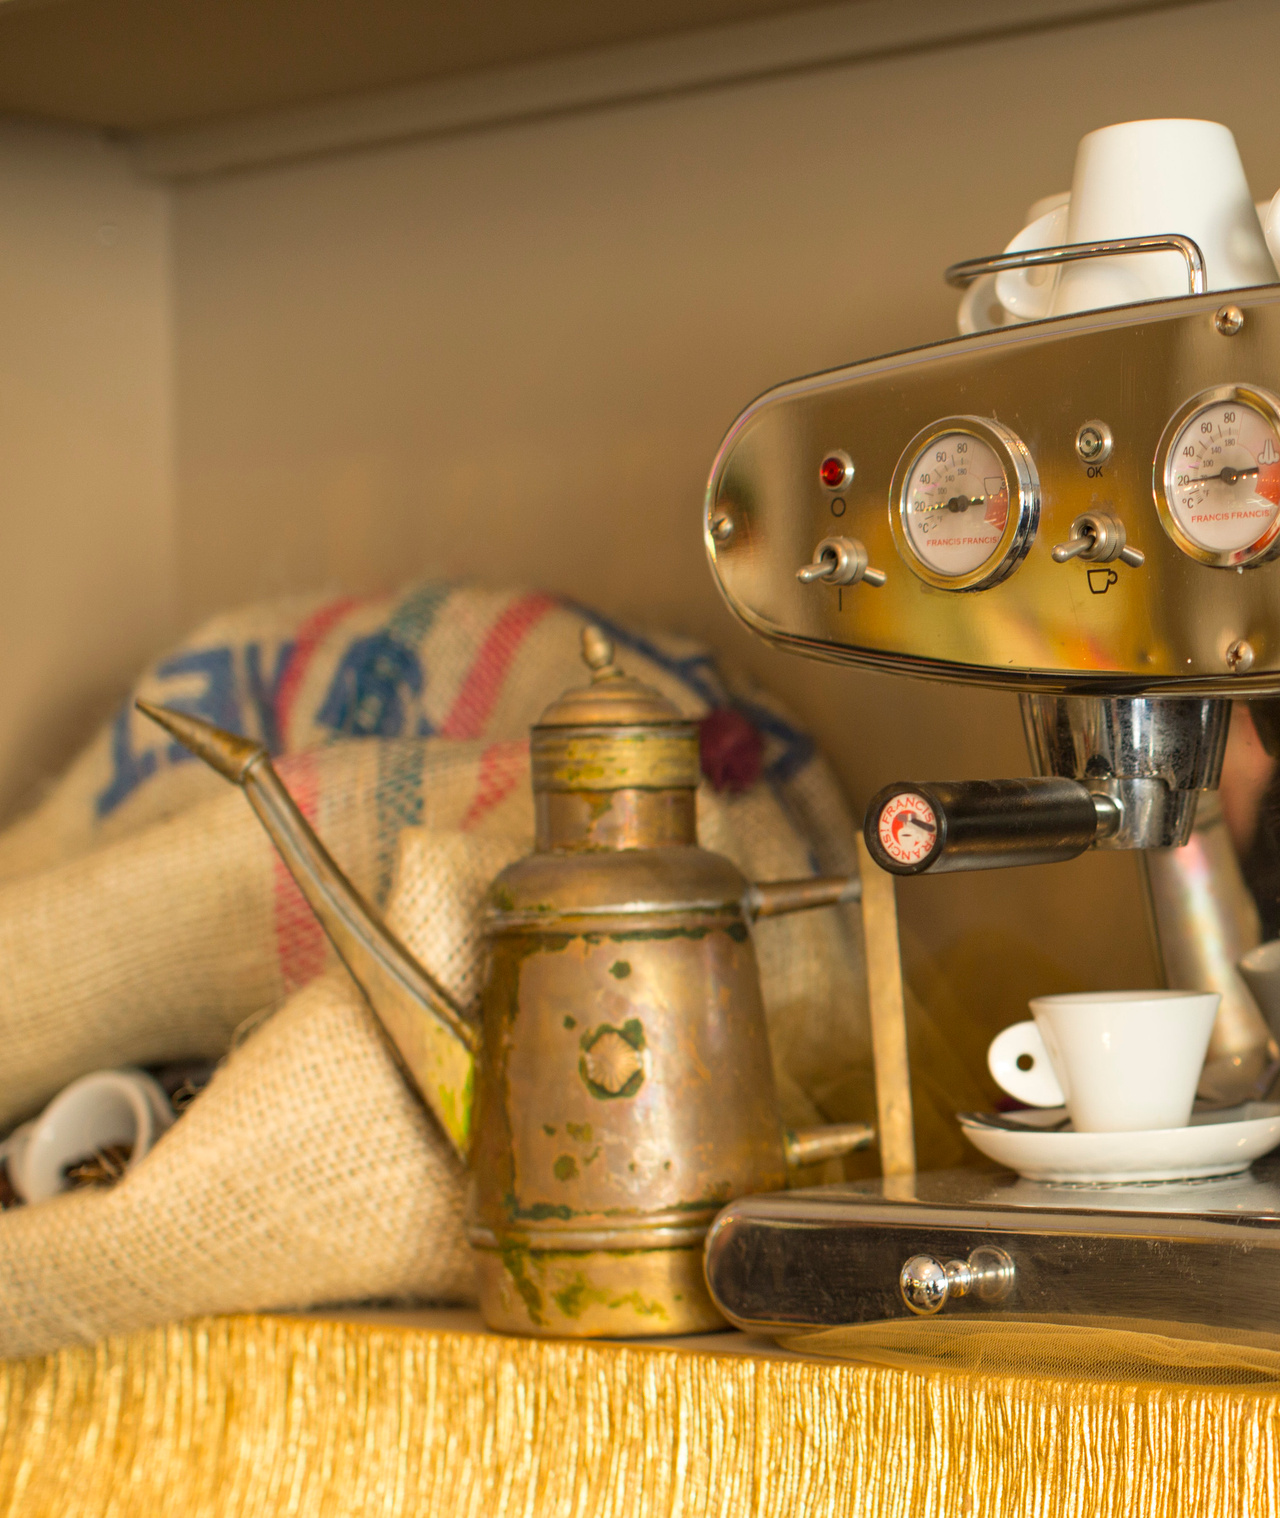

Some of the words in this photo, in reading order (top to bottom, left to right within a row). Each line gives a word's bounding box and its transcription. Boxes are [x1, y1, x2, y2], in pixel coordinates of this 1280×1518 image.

[1224, 412, 1235, 423] 80
[1201, 422, 1212, 433] 60
[1224, 438, 1235, 446] 180
[957, 443, 967, 453] 80
[1183, 446, 1194, 457] 40
[1211, 446, 1222, 454] 140
[936, 452, 947, 462] 60
[1087, 466, 1103, 478] OK
[920, 474, 930, 484] 40
[1178, 475, 1190, 487] 20
[915, 501, 926, 512] 20
[1191, 511, 1230, 523] FRANCIS
[926, 537, 961, 547] FRANCIS
[882, 797, 935, 824] FRANCIS
[880, 828, 937, 860] FRANCIS!
